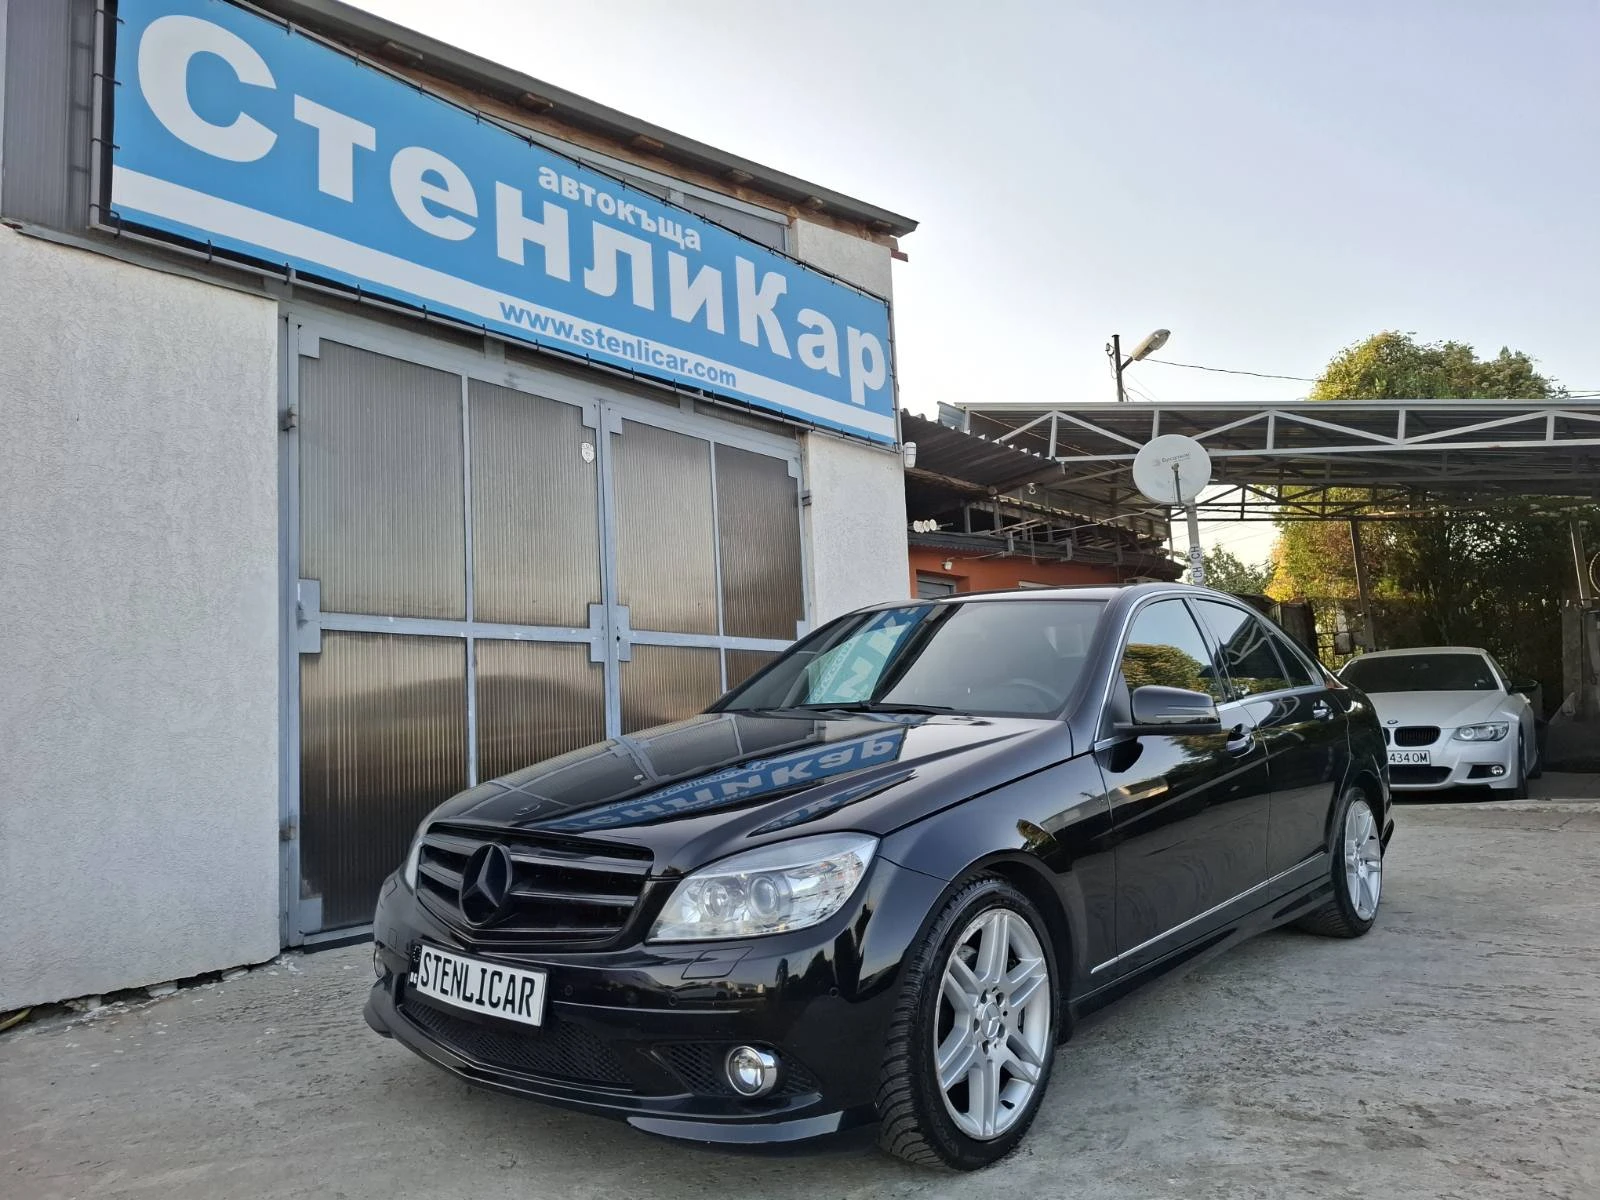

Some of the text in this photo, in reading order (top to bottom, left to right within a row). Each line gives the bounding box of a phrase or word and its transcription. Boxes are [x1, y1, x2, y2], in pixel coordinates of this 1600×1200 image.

[138, 14, 887, 407] СтенлиКар
[538, 166, 702, 252] автокъща
[500, 302, 737, 388] www.stenlicar.com
[1389, 752, 1410, 763] 434
[420, 951, 535, 1018] STENLICAR
